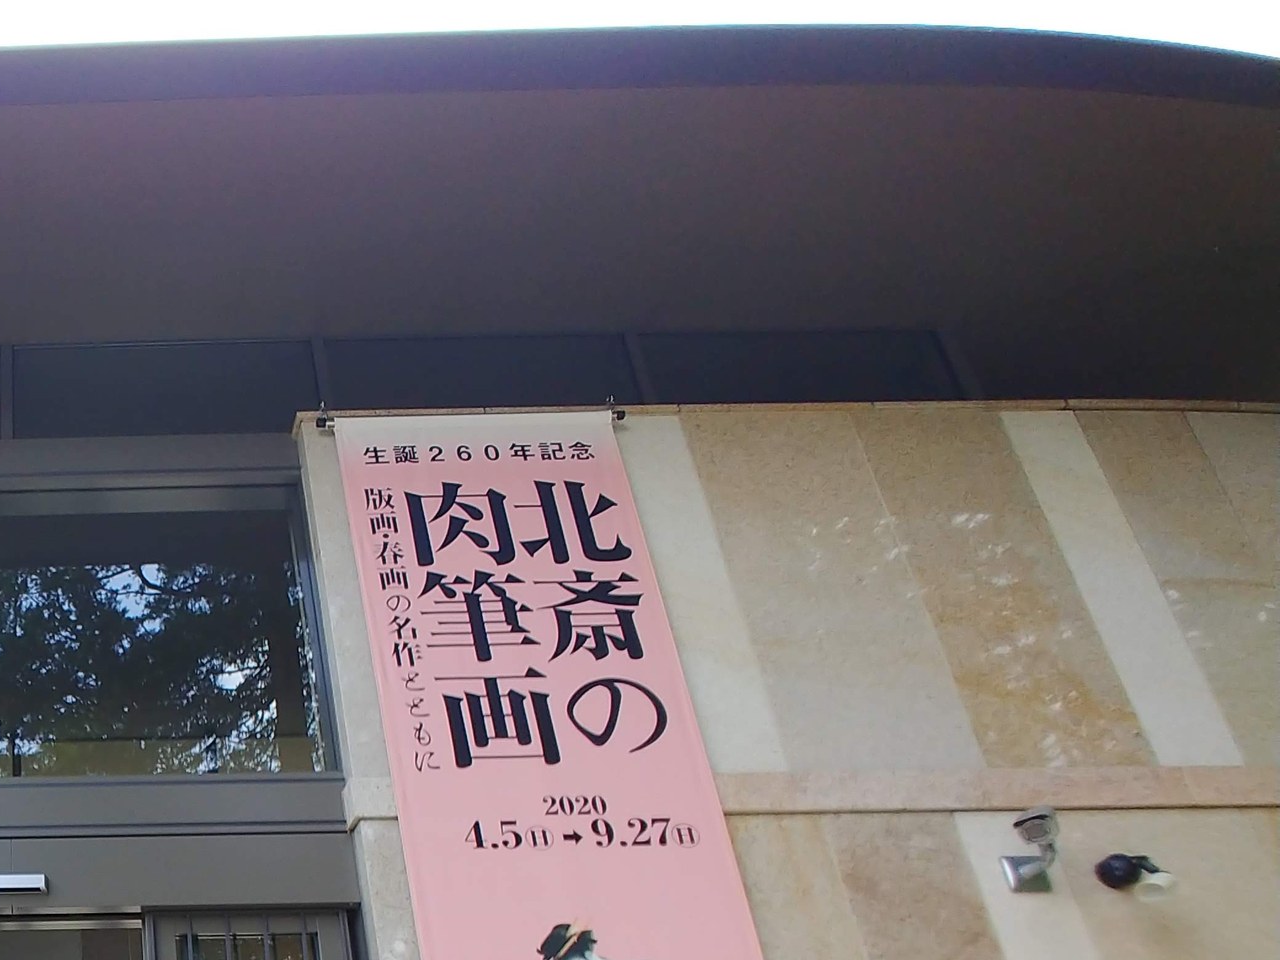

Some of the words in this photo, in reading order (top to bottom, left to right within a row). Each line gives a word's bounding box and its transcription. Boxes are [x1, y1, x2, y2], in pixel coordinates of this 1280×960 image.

[403, 481, 561, 768] 肉筆画
[514, 480, 667, 753] 北斎の
[542, 795, 608, 816] 2020
